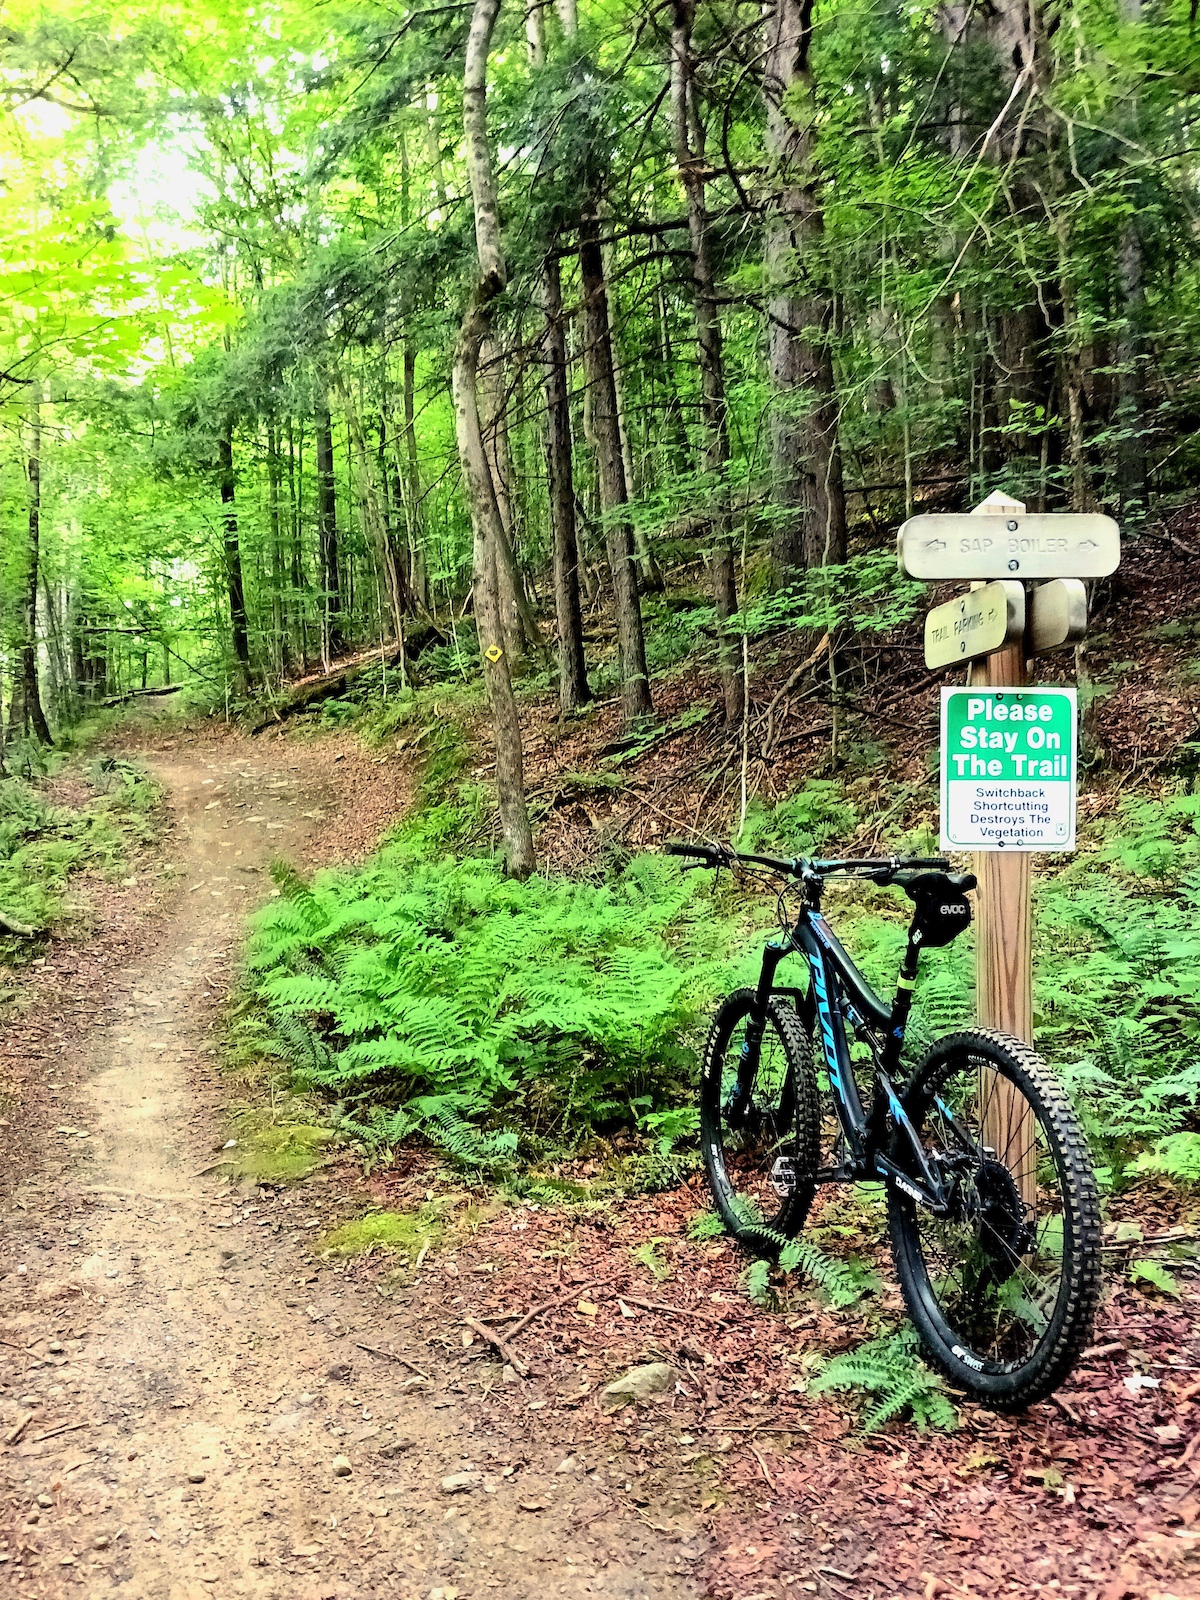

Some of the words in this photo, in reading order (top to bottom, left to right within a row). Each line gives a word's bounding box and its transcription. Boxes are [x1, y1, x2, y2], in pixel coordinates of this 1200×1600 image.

[960, 538, 993, 553] SAP
[1008, 538, 1068, 553] BOILER
[931, 625, 950, 644] TRAIL
[967, 698, 1053, 722] Please
[959, 726, 1018, 753] Stay
[1026, 726, 1061, 749] On
[952, 753, 1003, 777] The
[1010, 754, 1068, 777] Trail
[976, 787, 1046, 798] Switchback
[973, 801, 1049, 813] Shortcutting
[970, 814, 1025, 826] Destroys
[1029, 814, 1051, 824] The
[980, 827, 1044, 839] Vegetation
[809, 953, 846, 1105] PIVOT
[704, 1025, 720, 1079] MAXXIS
[963, 1354, 985, 1372] SWISS
